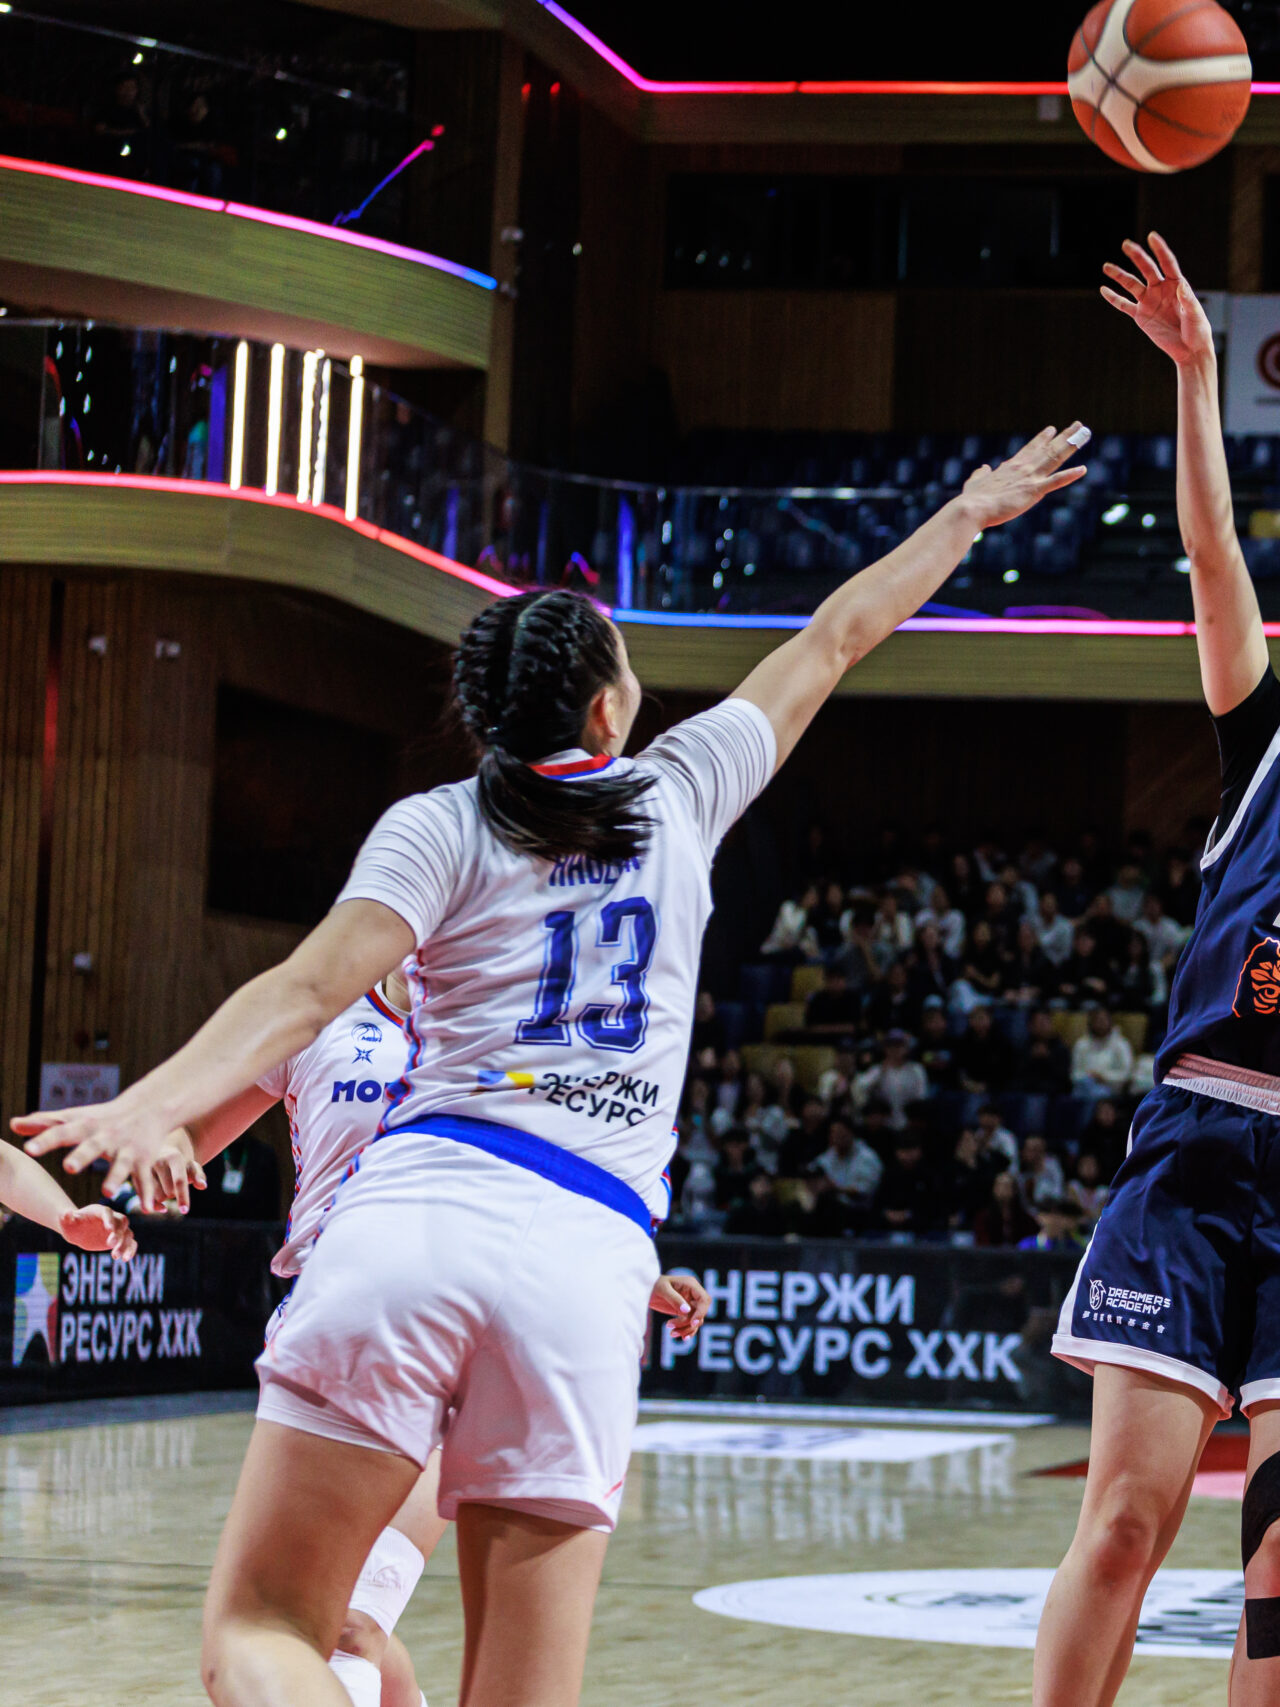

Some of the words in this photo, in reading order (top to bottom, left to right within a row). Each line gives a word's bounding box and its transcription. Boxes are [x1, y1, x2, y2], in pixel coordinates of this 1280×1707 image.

[514, 896, 658, 1053] 13
[62, 1252, 165, 1306] ЭНЕРЖИ
[667, 1267, 916, 1325] НЕРЖИ
[1105, 1297, 1161, 1315] ACADEMY
[1107, 1287, 1171, 1308] DREAMERS
[60, 1309, 153, 1363] РЕСУРС
[659, 1322, 892, 1380] РЕСУРС
